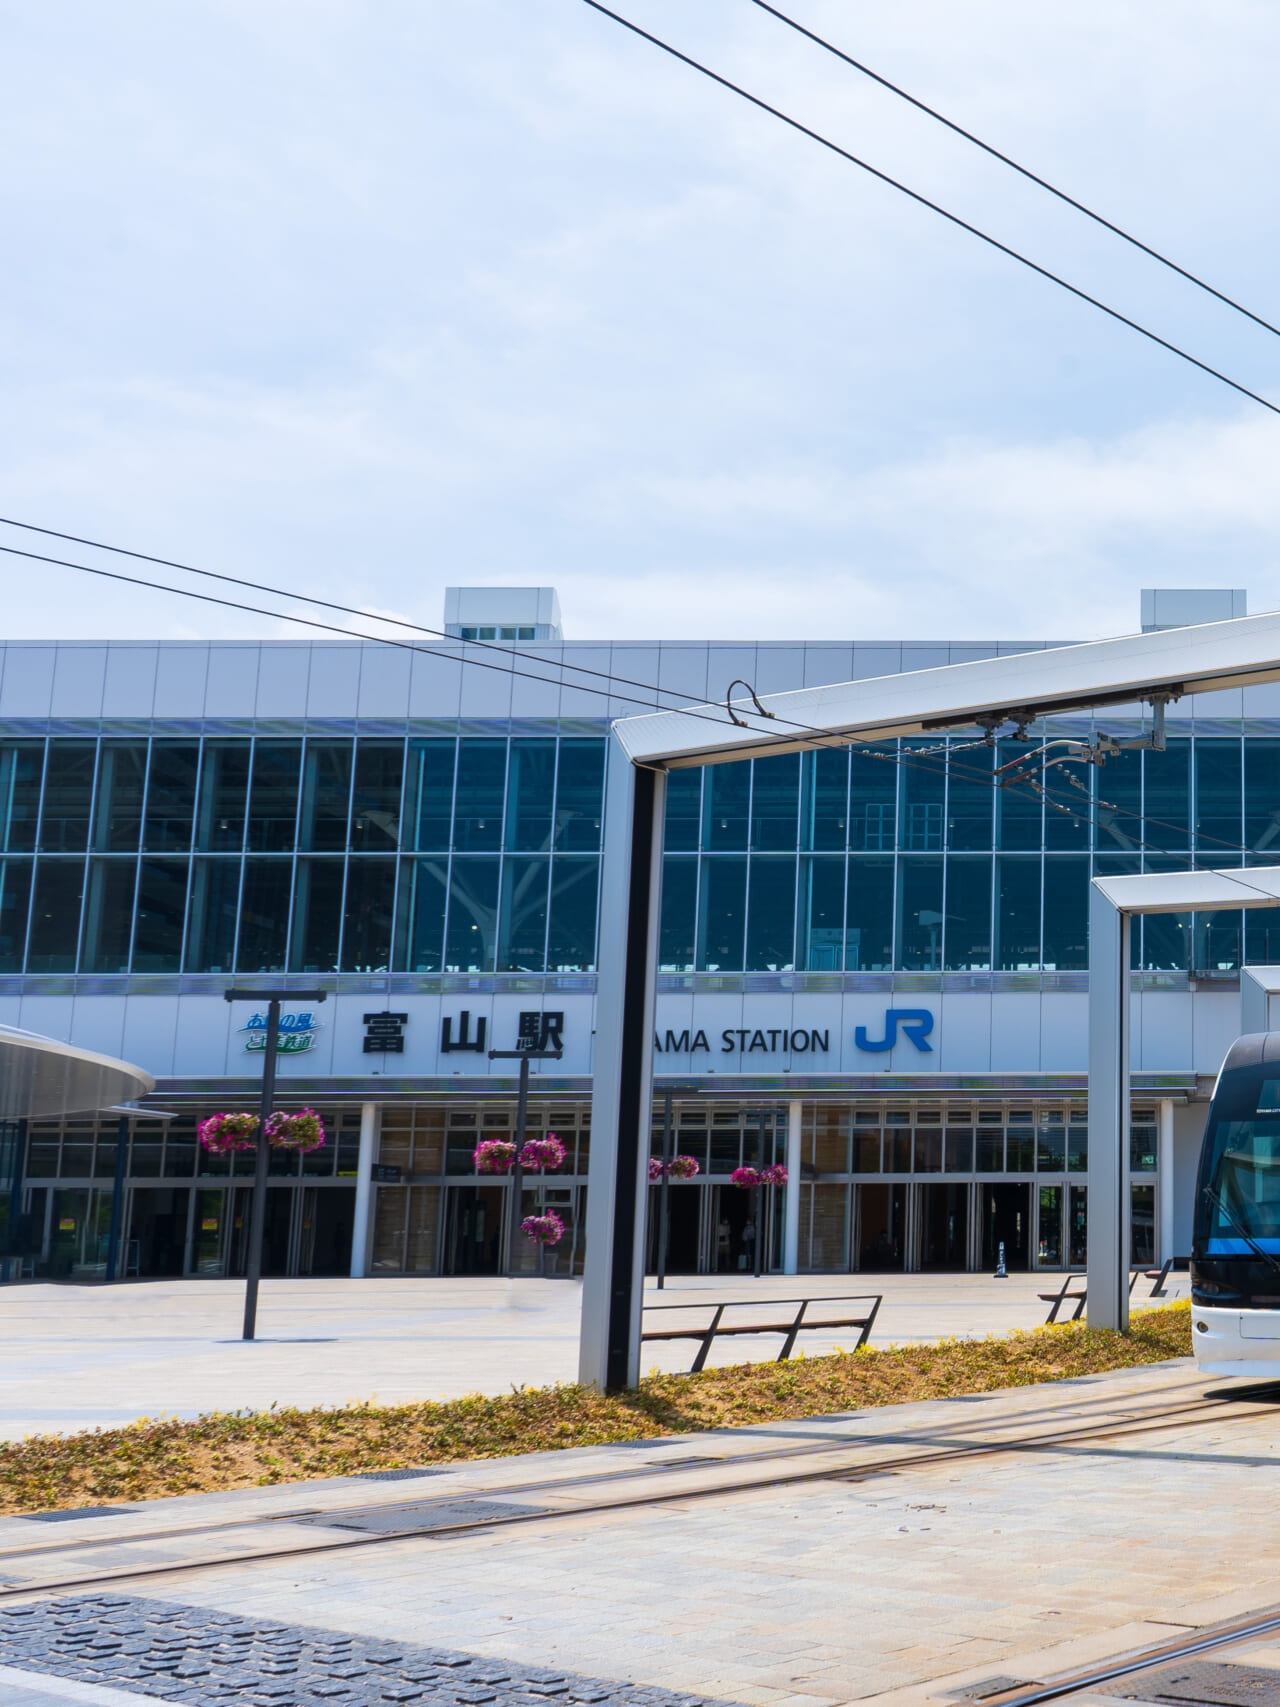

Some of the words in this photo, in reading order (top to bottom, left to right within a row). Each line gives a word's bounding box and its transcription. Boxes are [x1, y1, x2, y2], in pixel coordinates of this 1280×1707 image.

[363, 1011, 564, 1053] 富山駅
[721, 1029, 829, 1053] STATION
[855, 1009, 934, 1052] JR
